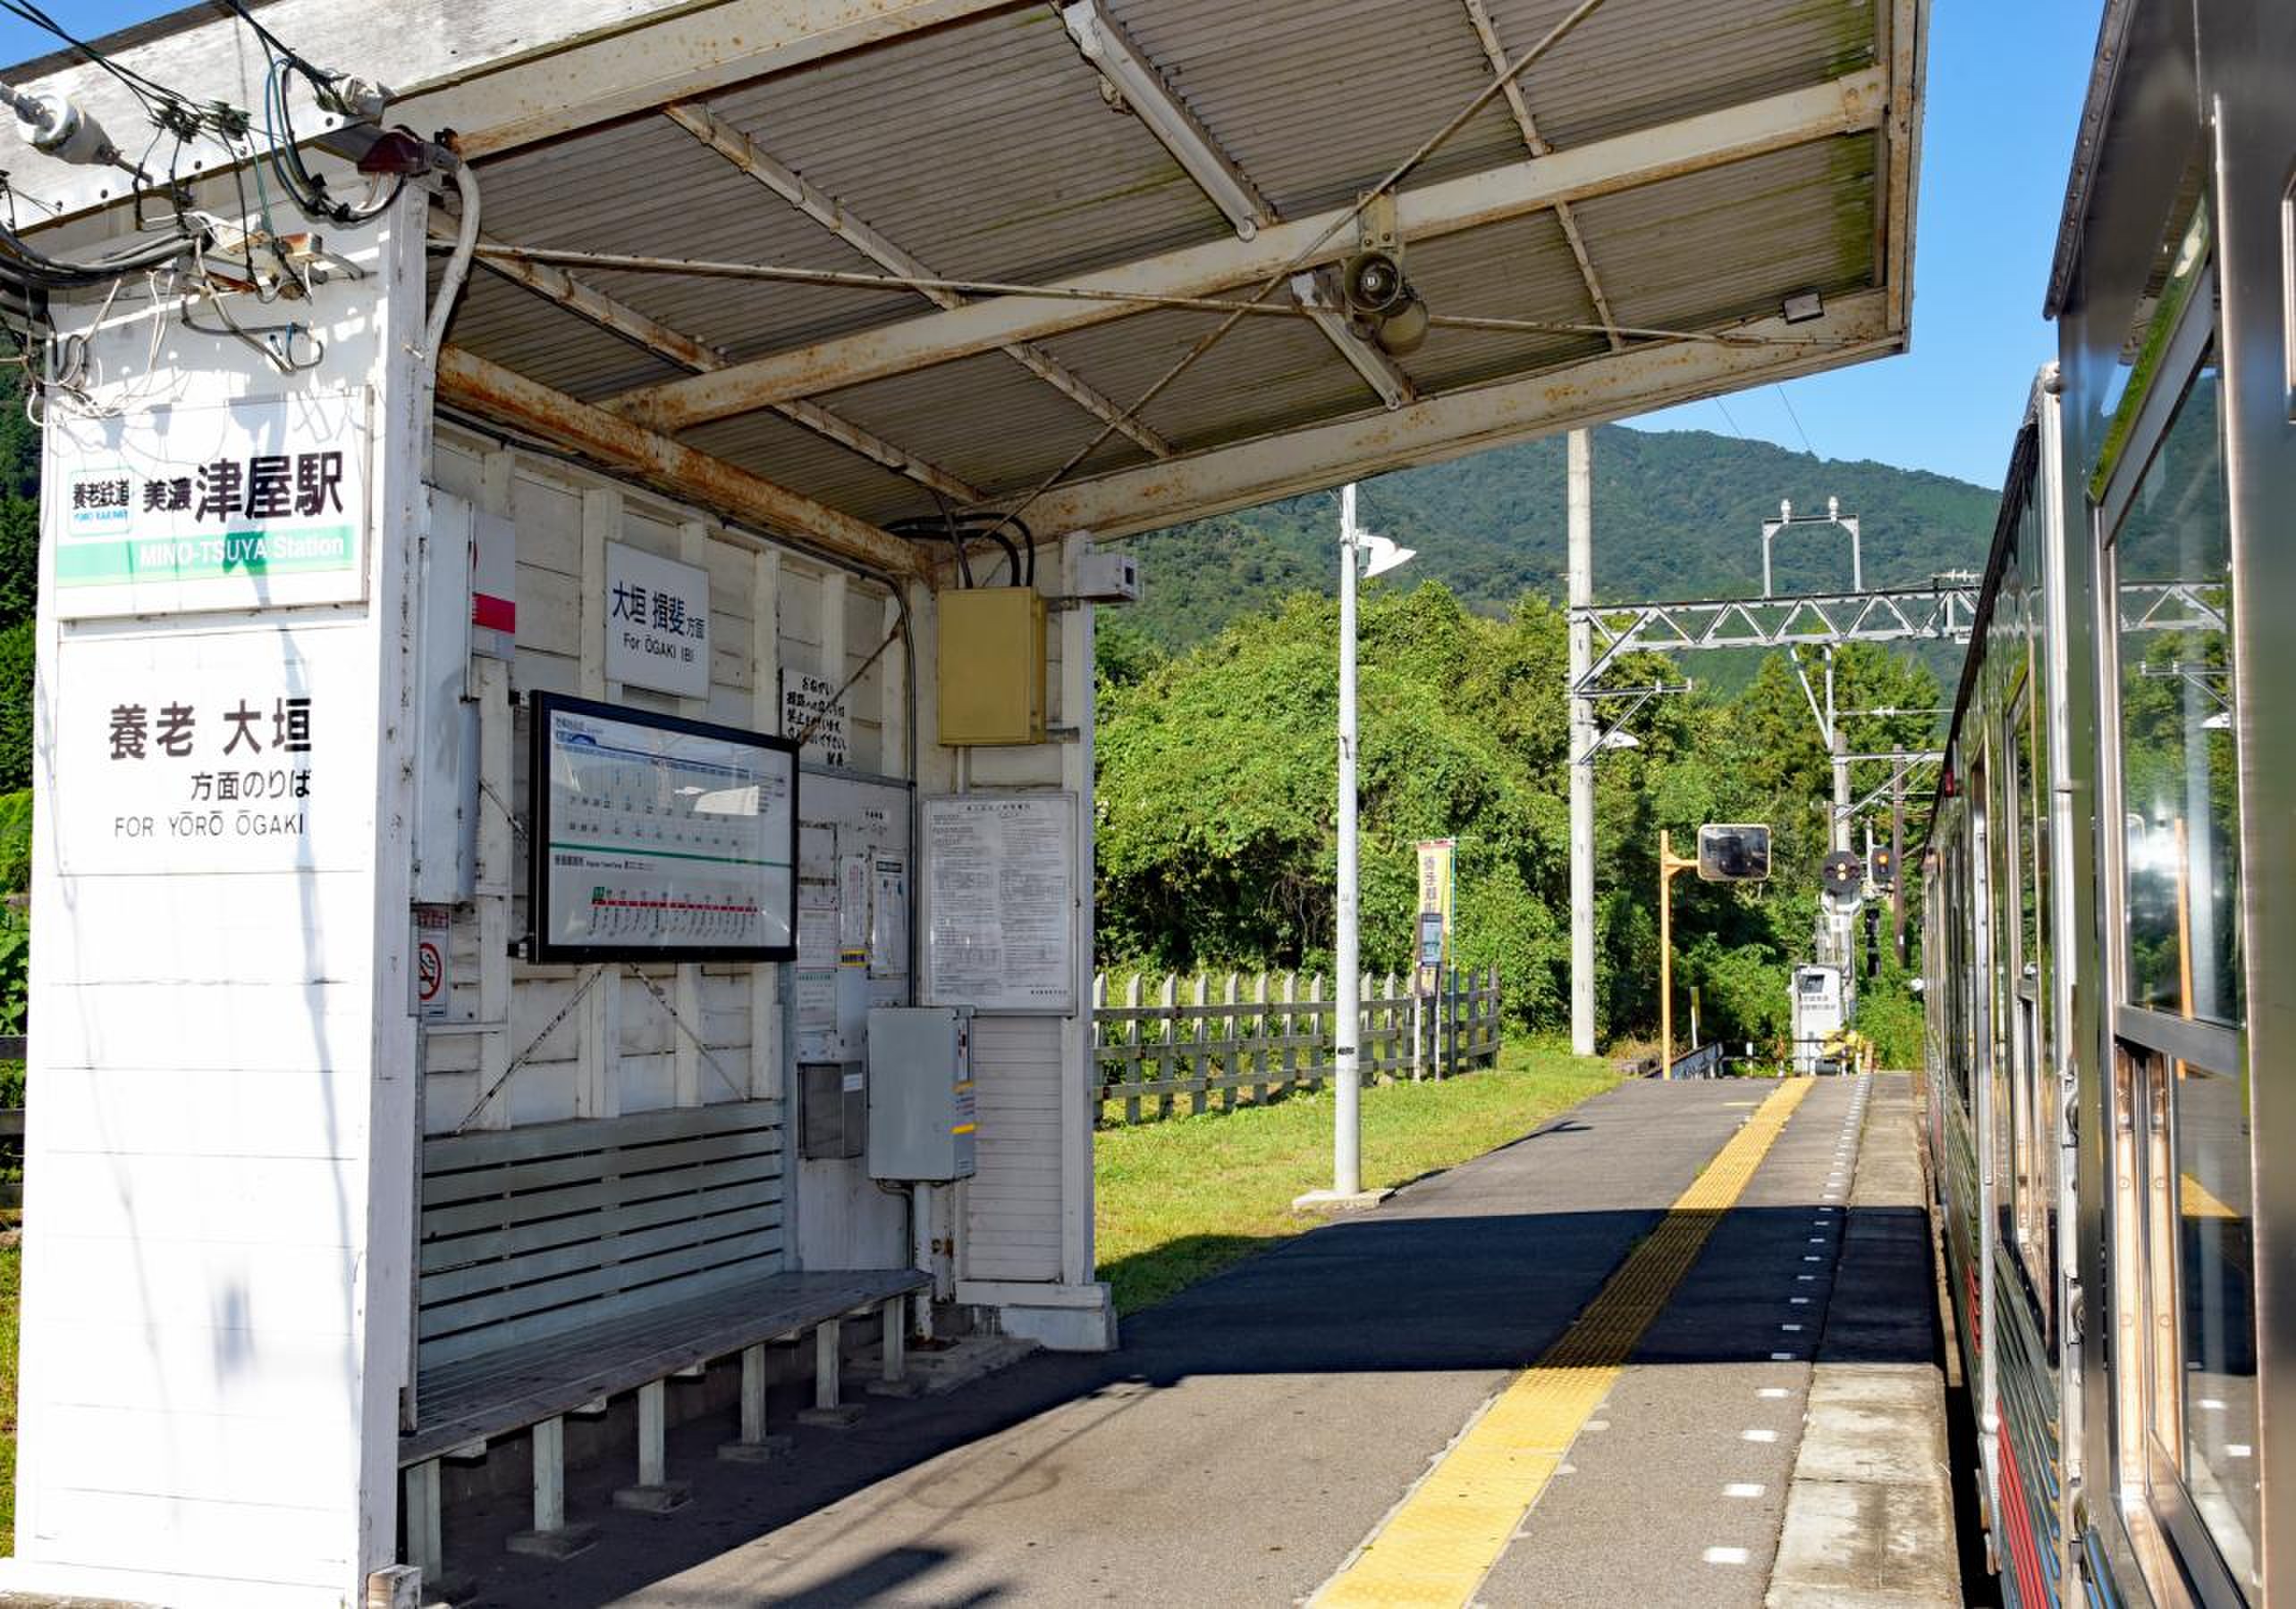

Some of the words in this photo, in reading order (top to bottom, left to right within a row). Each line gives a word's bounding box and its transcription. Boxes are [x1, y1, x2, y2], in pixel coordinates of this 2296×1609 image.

[72, 478, 130, 510] 養老鉄道
[139, 535, 266, 568] MINO-TSUYA
[274, 534, 343, 560] Station
[612, 580, 646, 625] 大垣
[623, 632, 640, 651] For
[110, 701, 195, 760] 養老
[223, 697, 311, 755] 大垣
[190, 769, 311, 801] 方面のりば
[114, 816, 154, 838] FOR
